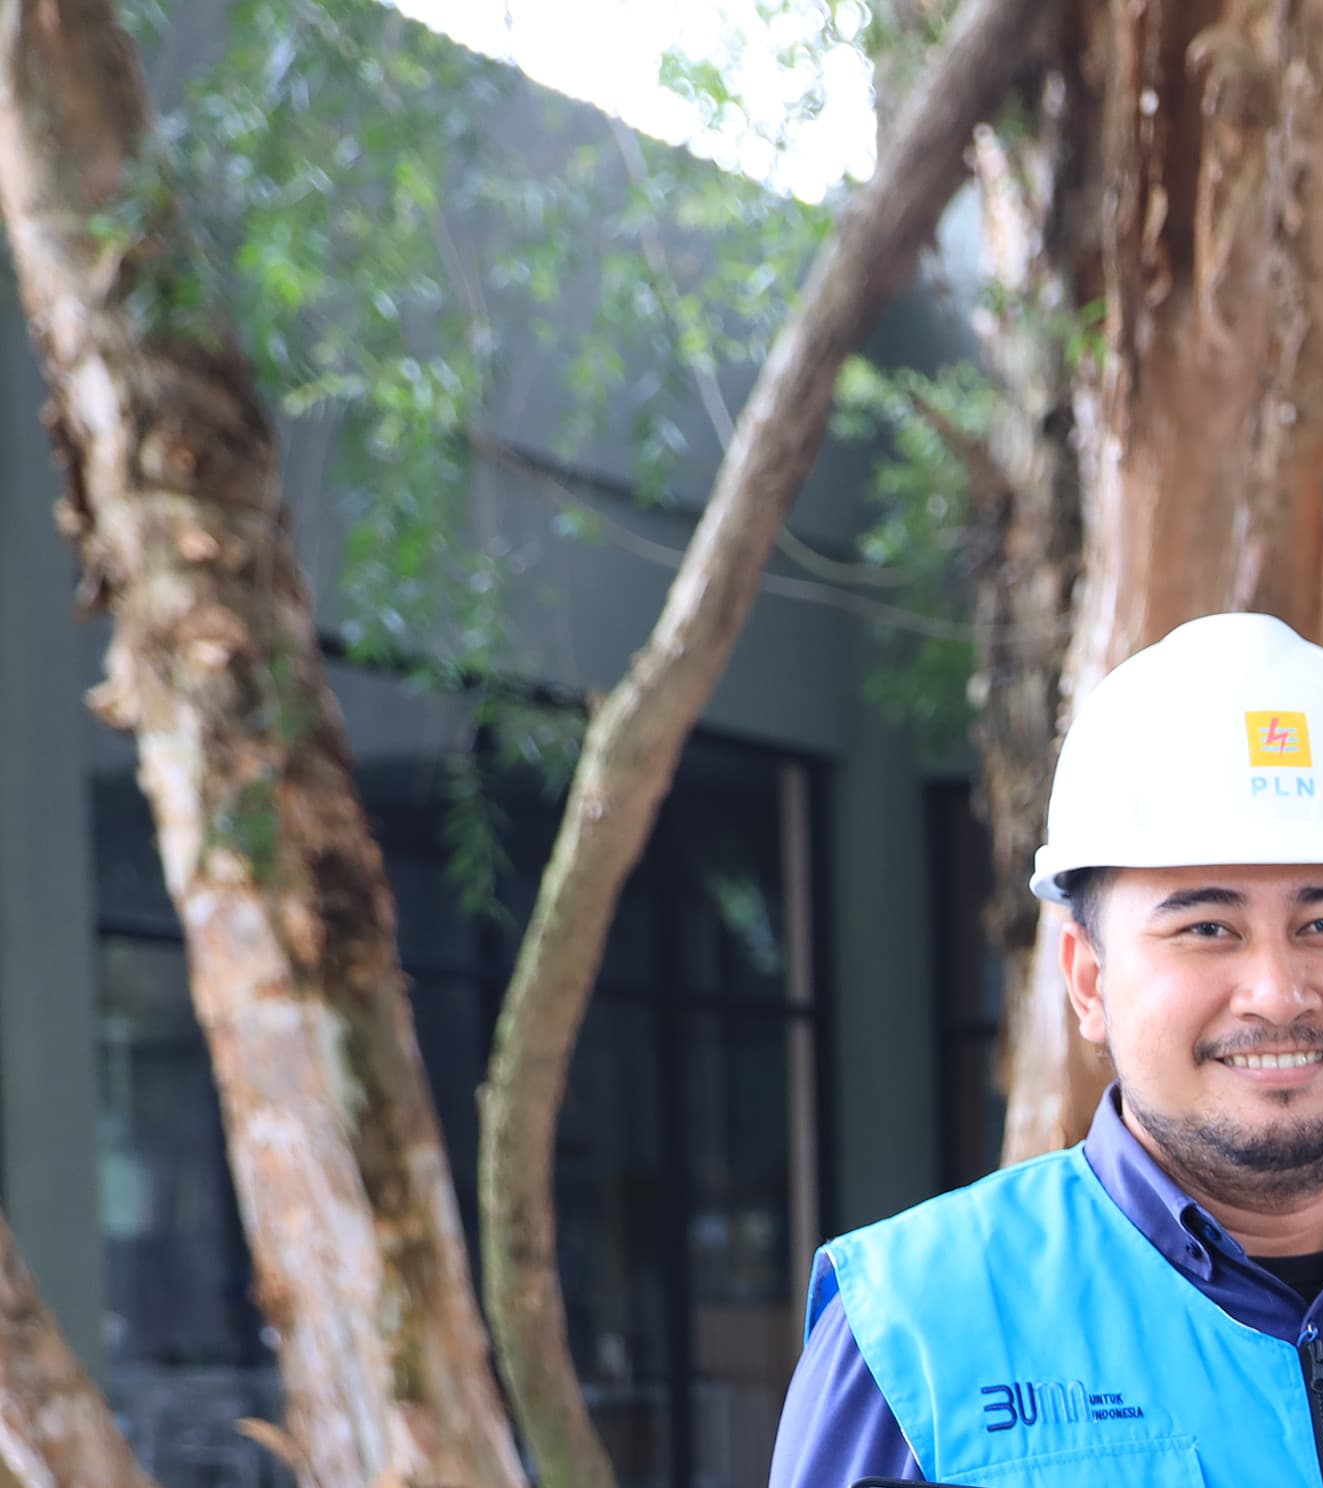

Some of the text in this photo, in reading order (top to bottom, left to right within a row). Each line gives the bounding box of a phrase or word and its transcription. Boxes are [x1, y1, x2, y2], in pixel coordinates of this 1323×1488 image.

[1250, 776, 1316, 798] PLN
[1088, 1393, 1124, 1405] UNTUK
[1091, 1406, 1144, 1420] INDONESIA
